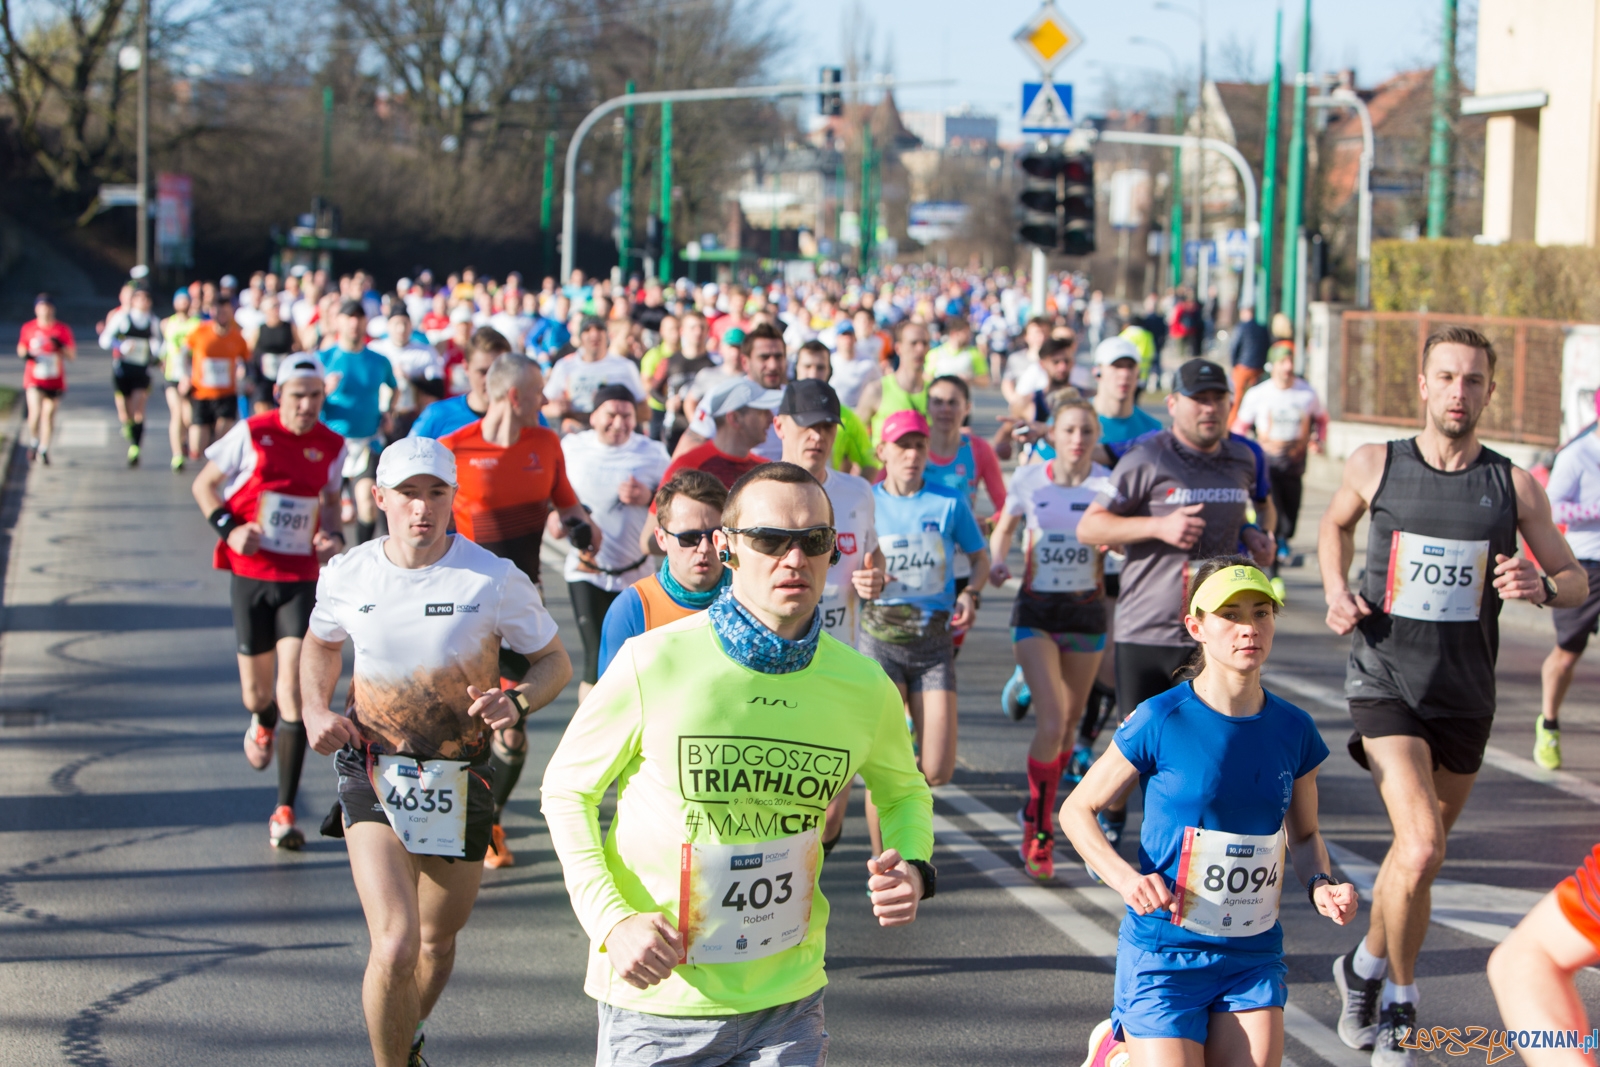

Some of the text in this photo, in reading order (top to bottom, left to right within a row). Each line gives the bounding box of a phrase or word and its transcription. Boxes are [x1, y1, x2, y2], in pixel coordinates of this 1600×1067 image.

[269, 510, 309, 530] 8981
[886, 552, 935, 572] 7244
[1041, 547, 1089, 564] 3498
[1410, 561, 1473, 586] 7035
[359, 604, 376, 613] 4F
[437, 605, 452, 613] PKO
[820, 606, 846, 629] 57
[688, 744, 843, 777] BYDGOSZCZ
[689, 768, 839, 801] TRIATHLON
[386, 786, 453, 814] 4635
[408, 815, 428, 823] Karol
[734, 859, 744, 867] 10.
[744, 857, 761, 866] PKO
[1203, 862, 1277, 894] 8094
[721, 871, 793, 912] 403
[1223, 897, 1264, 906] Agnieszka
[743, 912, 775, 924] Robert
